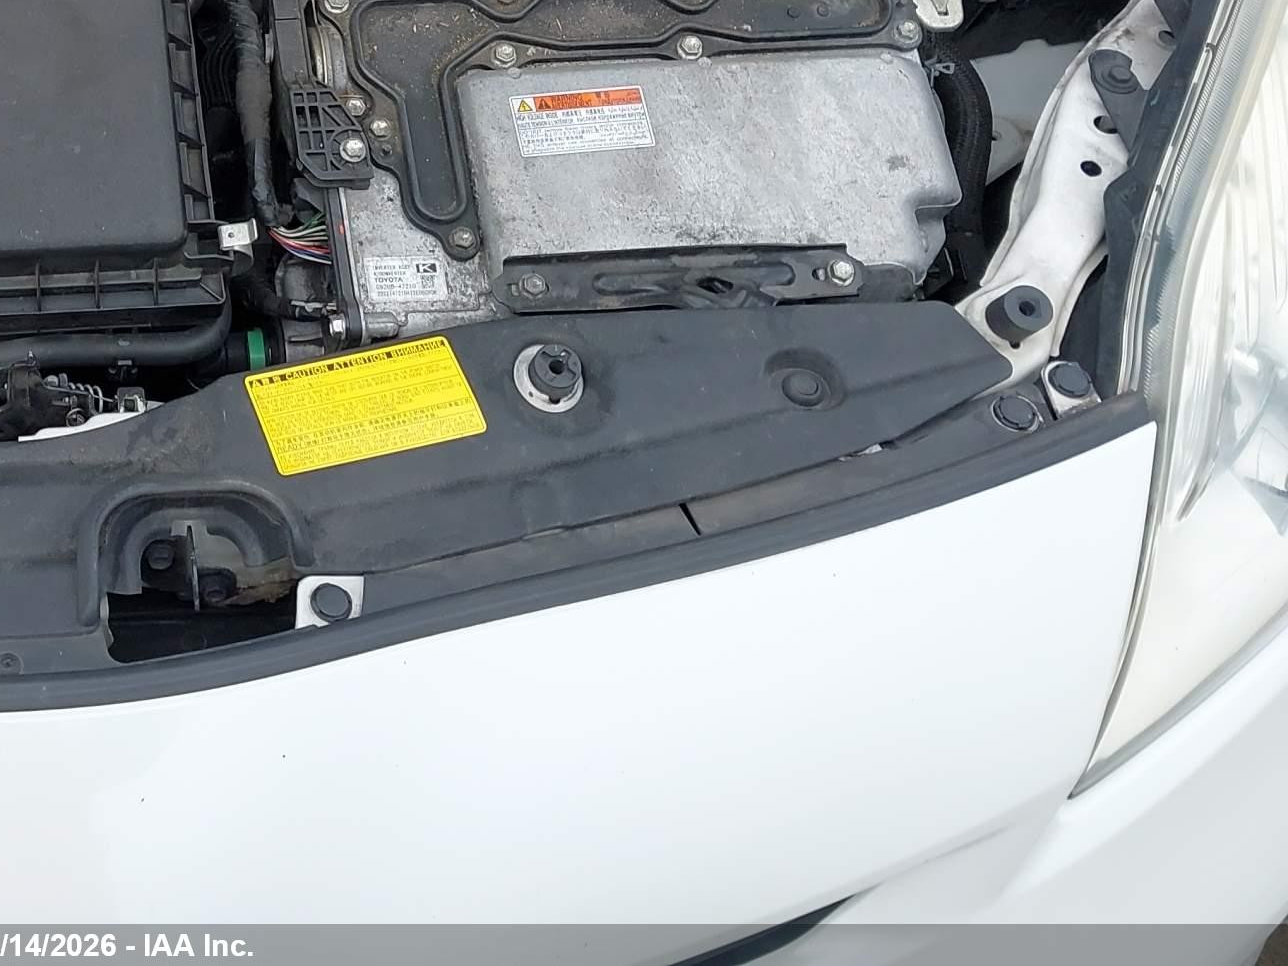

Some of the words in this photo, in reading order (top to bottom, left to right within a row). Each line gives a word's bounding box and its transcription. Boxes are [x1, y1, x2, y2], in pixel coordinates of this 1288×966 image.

[286, 365, 329, 381] CAUTION
[332, 353, 387, 370] ATTENTION
[392, 340, 444, 357] ВНИМАНИЕ
